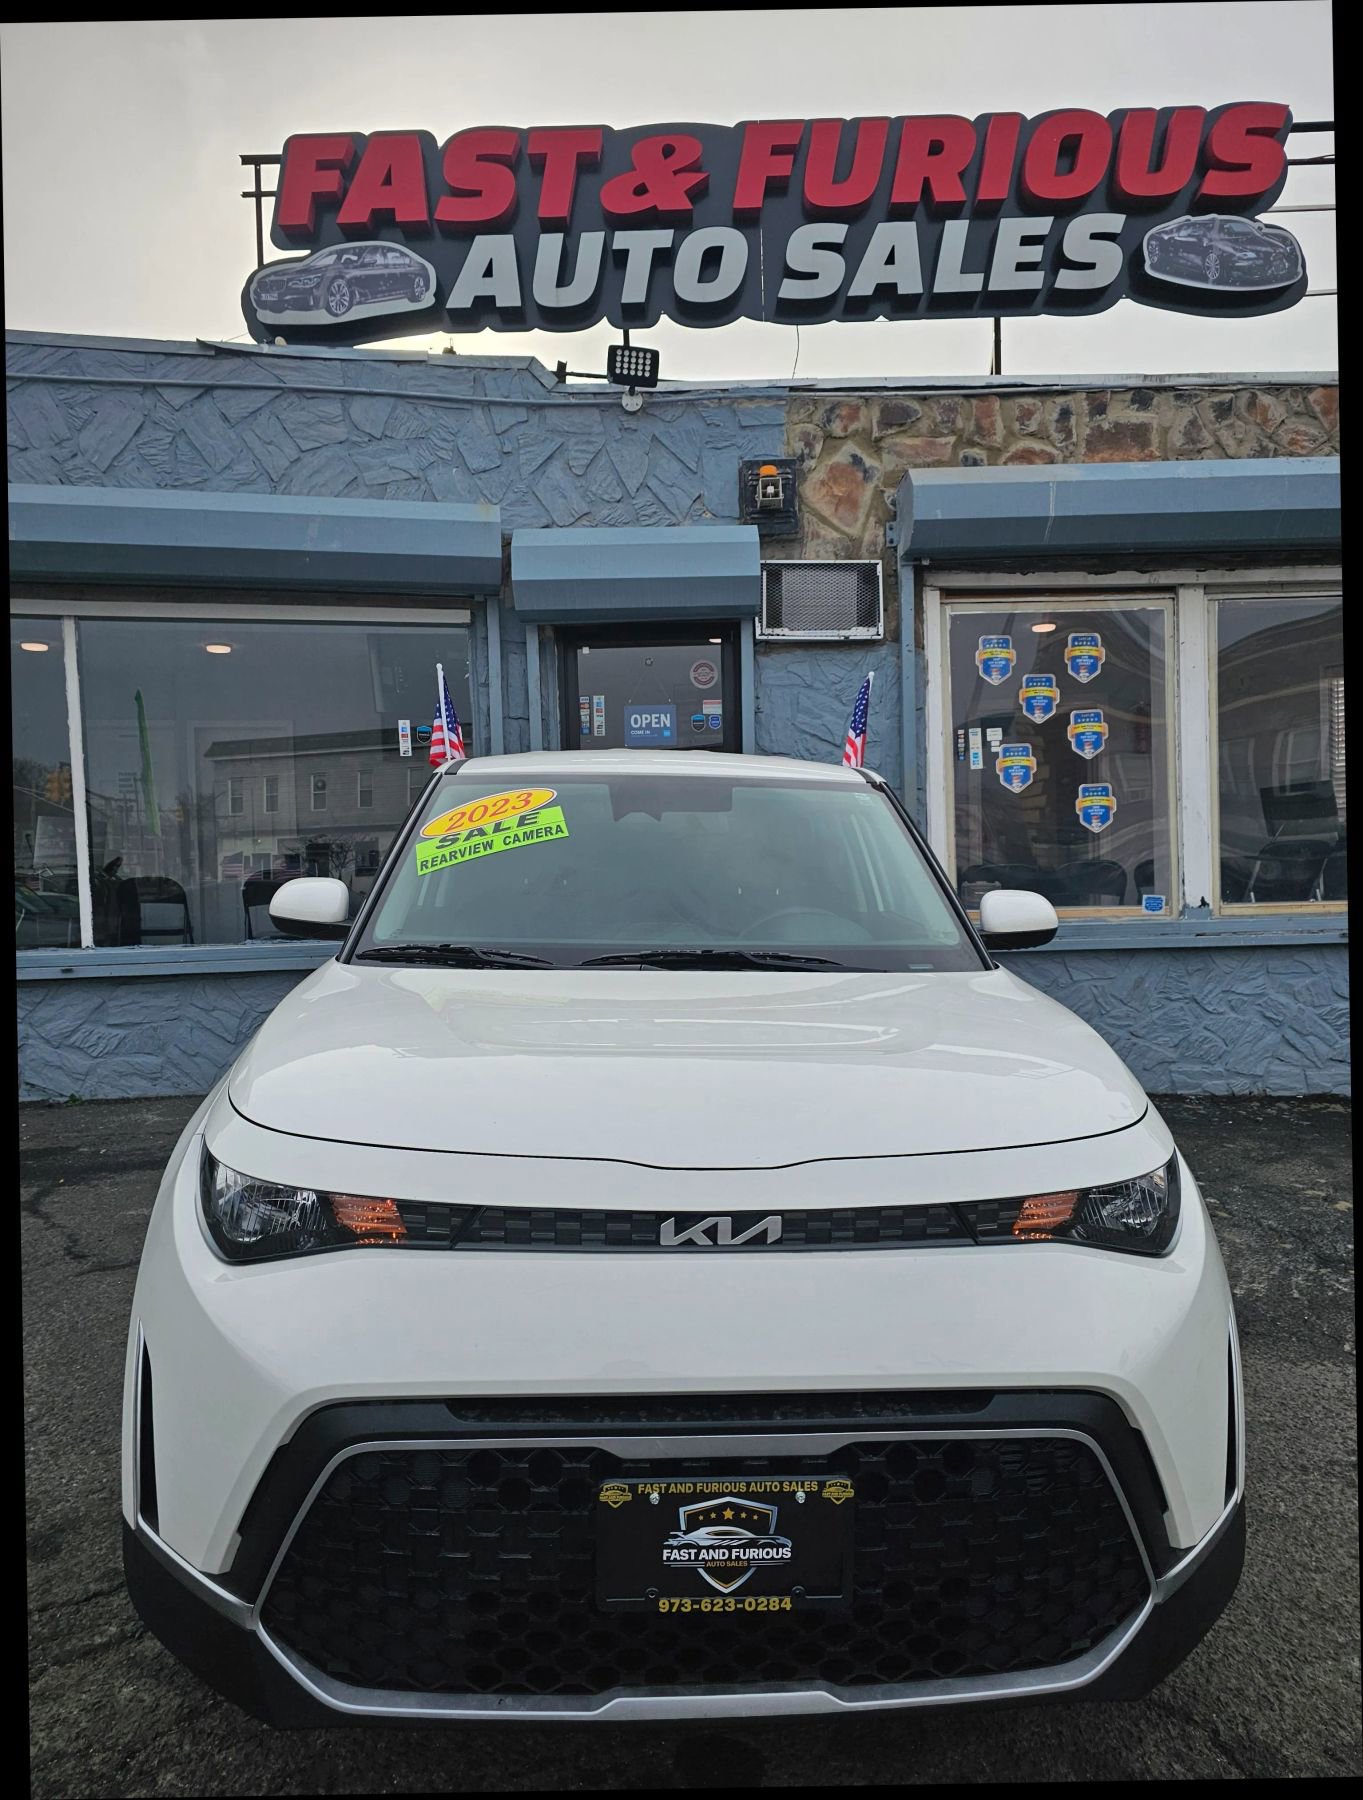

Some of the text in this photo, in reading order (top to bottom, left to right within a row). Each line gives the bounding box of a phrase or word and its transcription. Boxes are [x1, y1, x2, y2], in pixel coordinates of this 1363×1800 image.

[277, 103, 1290, 230] FAST & FURIOUS
[445, 213, 1127, 308] AUTO SALES
[630, 713, 671, 728] OPEN
[444, 791, 534, 833] 2023
[419, 823, 565, 872] REARVIEW CAMERA
[435, 810, 542, 850] SALE
[660, 1215, 782, 1246] KIA
[637, 1481, 818, 1495] FAST AND FURIOUS AUTO SALES
[662, 1547, 792, 1561] FAST AND FURIOUS
[658, 1597, 793, 1613] 973-623-0284
